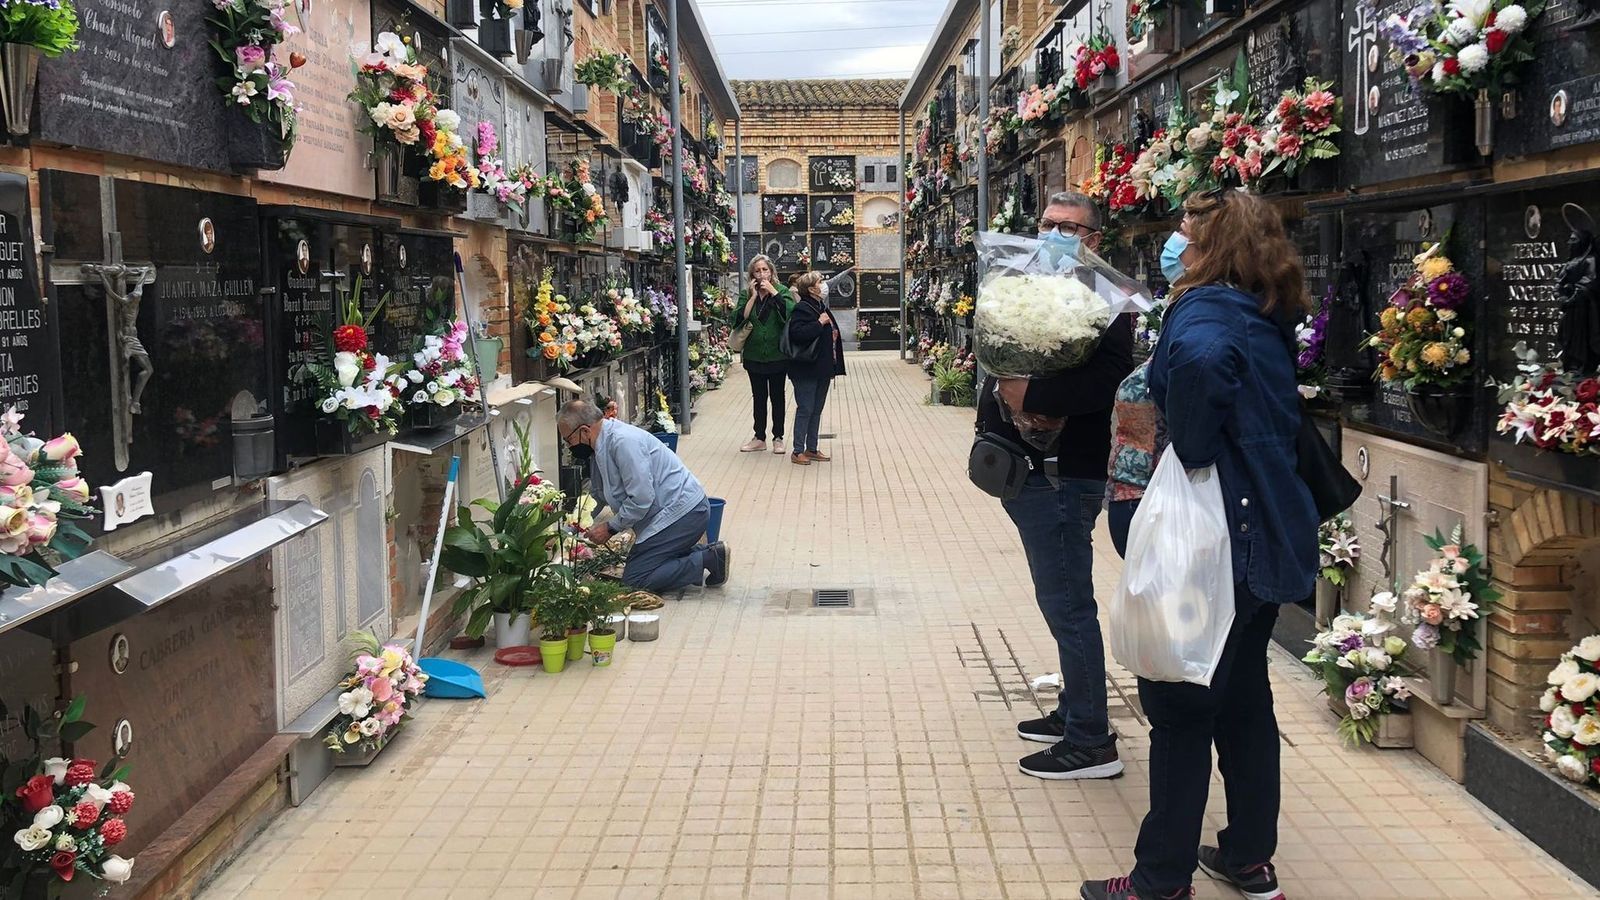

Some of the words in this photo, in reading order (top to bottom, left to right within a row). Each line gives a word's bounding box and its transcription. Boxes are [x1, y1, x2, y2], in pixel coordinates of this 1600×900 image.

[99, 0, 142, 19] onsuelo
[1512, 241, 1557, 259] TERESA
[7, 262, 24, 280] AÑOS
[160, 280, 197, 299] JUANITA
[200, 280, 222, 298] MAZA
[12, 331, 28, 347] AÑOS
